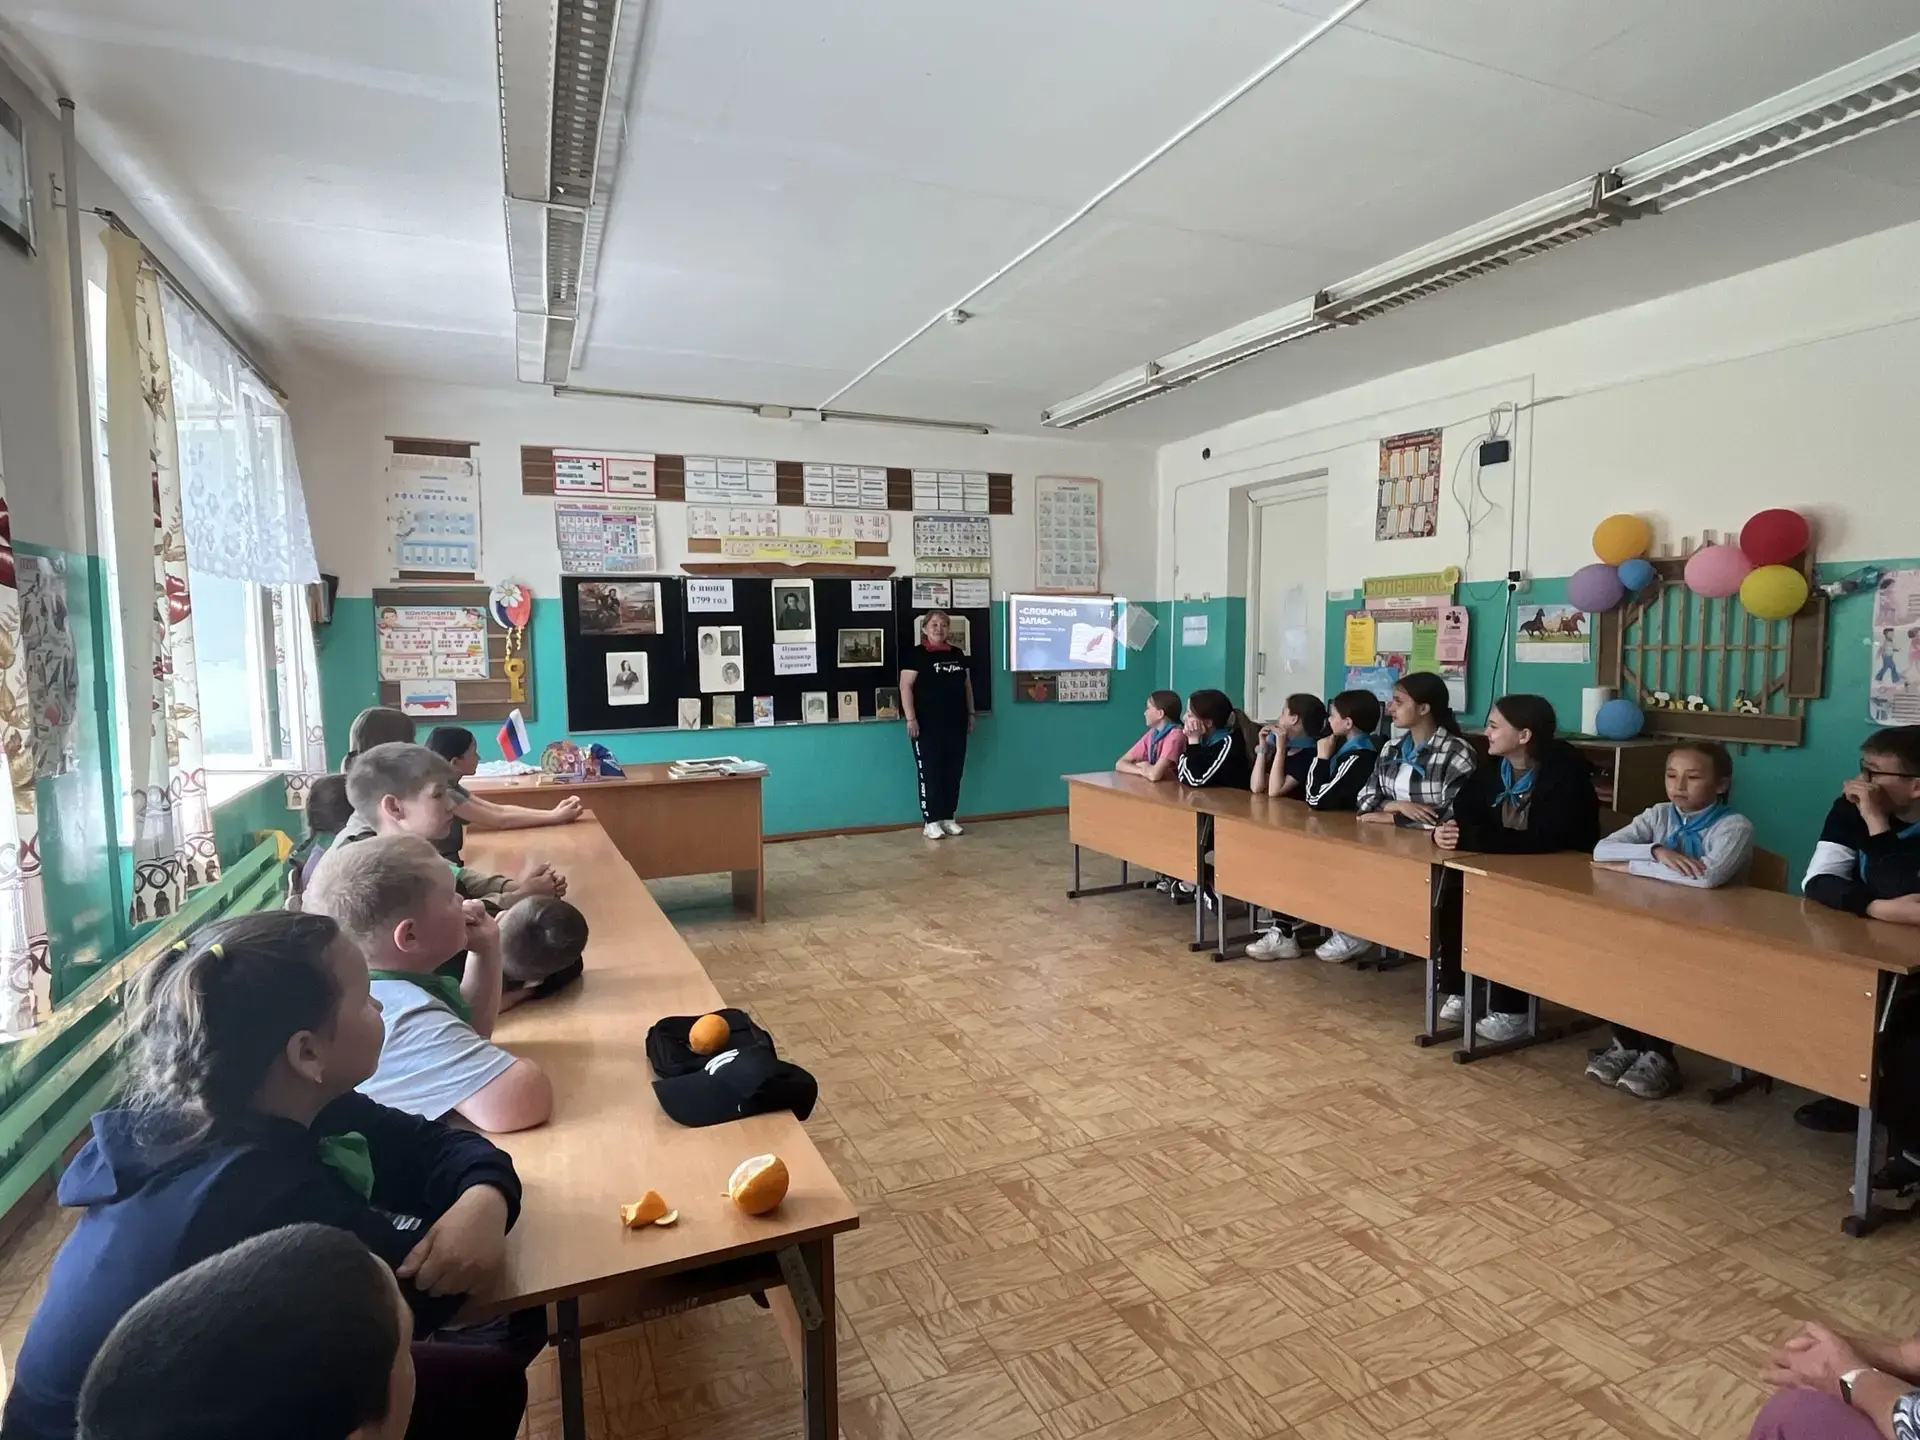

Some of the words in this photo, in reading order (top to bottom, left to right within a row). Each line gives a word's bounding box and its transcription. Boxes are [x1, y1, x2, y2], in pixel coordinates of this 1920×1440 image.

[690, 584, 696, 592] 6
[858, 583, 871, 591] 227
[1366, 576, 1447, 595] СОЛНЫШКО
[692, 596, 711, 605] 1799
[1019, 607, 1077, 617] «СЛОВАРНЫЙ
[1019, 617, 1052, 625] ЗАПАС»
